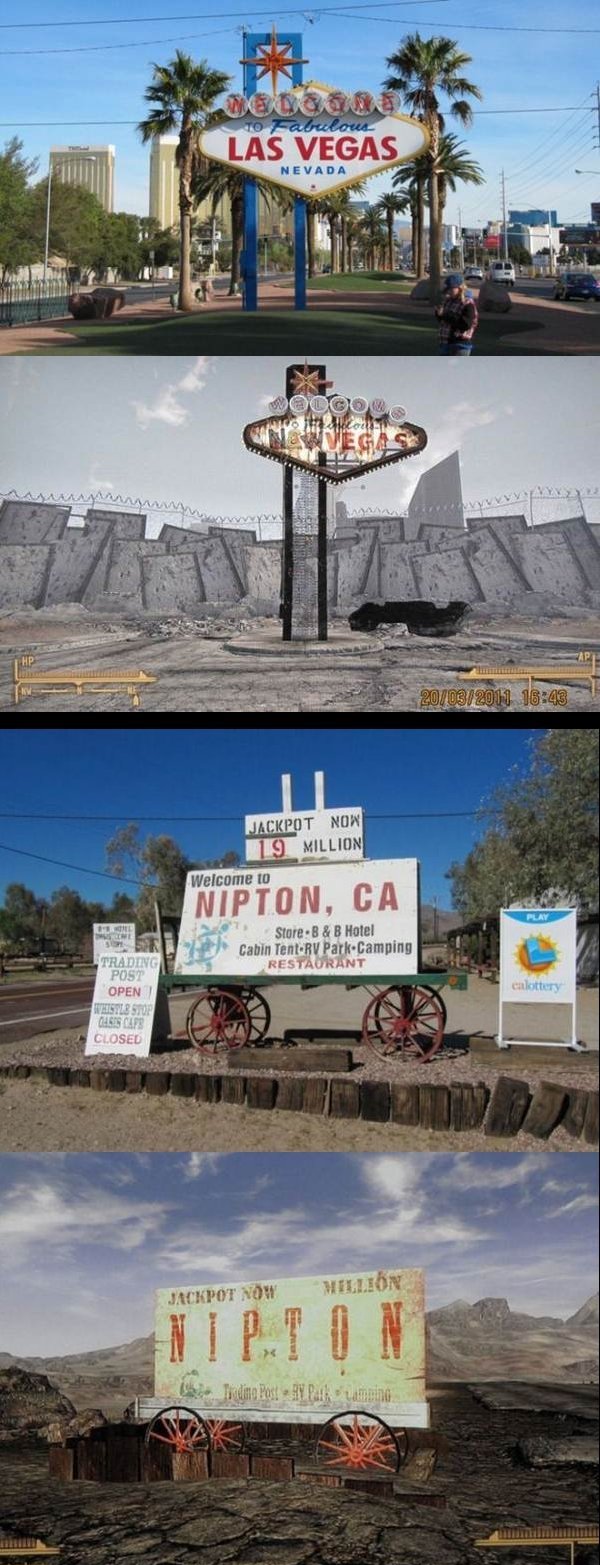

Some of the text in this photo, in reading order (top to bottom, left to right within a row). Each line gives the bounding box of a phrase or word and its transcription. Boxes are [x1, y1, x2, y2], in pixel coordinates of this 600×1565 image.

[227, 93, 397, 115] WELCOME
[245, 118, 375, 135] TO Fabulous
[228, 136, 398, 161] LAS VEGAS
[281, 166, 346, 175] NEVADA
[325, 431, 409, 451] VEGAS
[249, 814, 361, 836] JACKPOT NOW
[258, 837, 362, 859] 19 MILLION
[191, 873, 271, 888] Welcome to
[195, 882, 399, 919] NIPTON, CA
[527, 913, 549, 921] PLAY
[275, 924, 374, 939] Store B & B Hotel
[239, 943, 271, 956] Cabin
[357, 941, 413, 956] Camping
[101, 957, 158, 968] TRADING
[268, 958, 366, 970] RESTAURANT
[111, 970, 145, 981] POST
[108, 987, 141, 997] OPEN
[512, 980, 561, 993] calottery
[94, 1003, 153, 1016] WHISTLE STOP
[98, 1017, 144, 1030] OASIS CAFE
[94, 1034, 142, 1045] CLOSED
[168, 1272, 402, 1305] JACKPOT NOW MILLION
[169, 1301, 403, 1363] NIPTON
